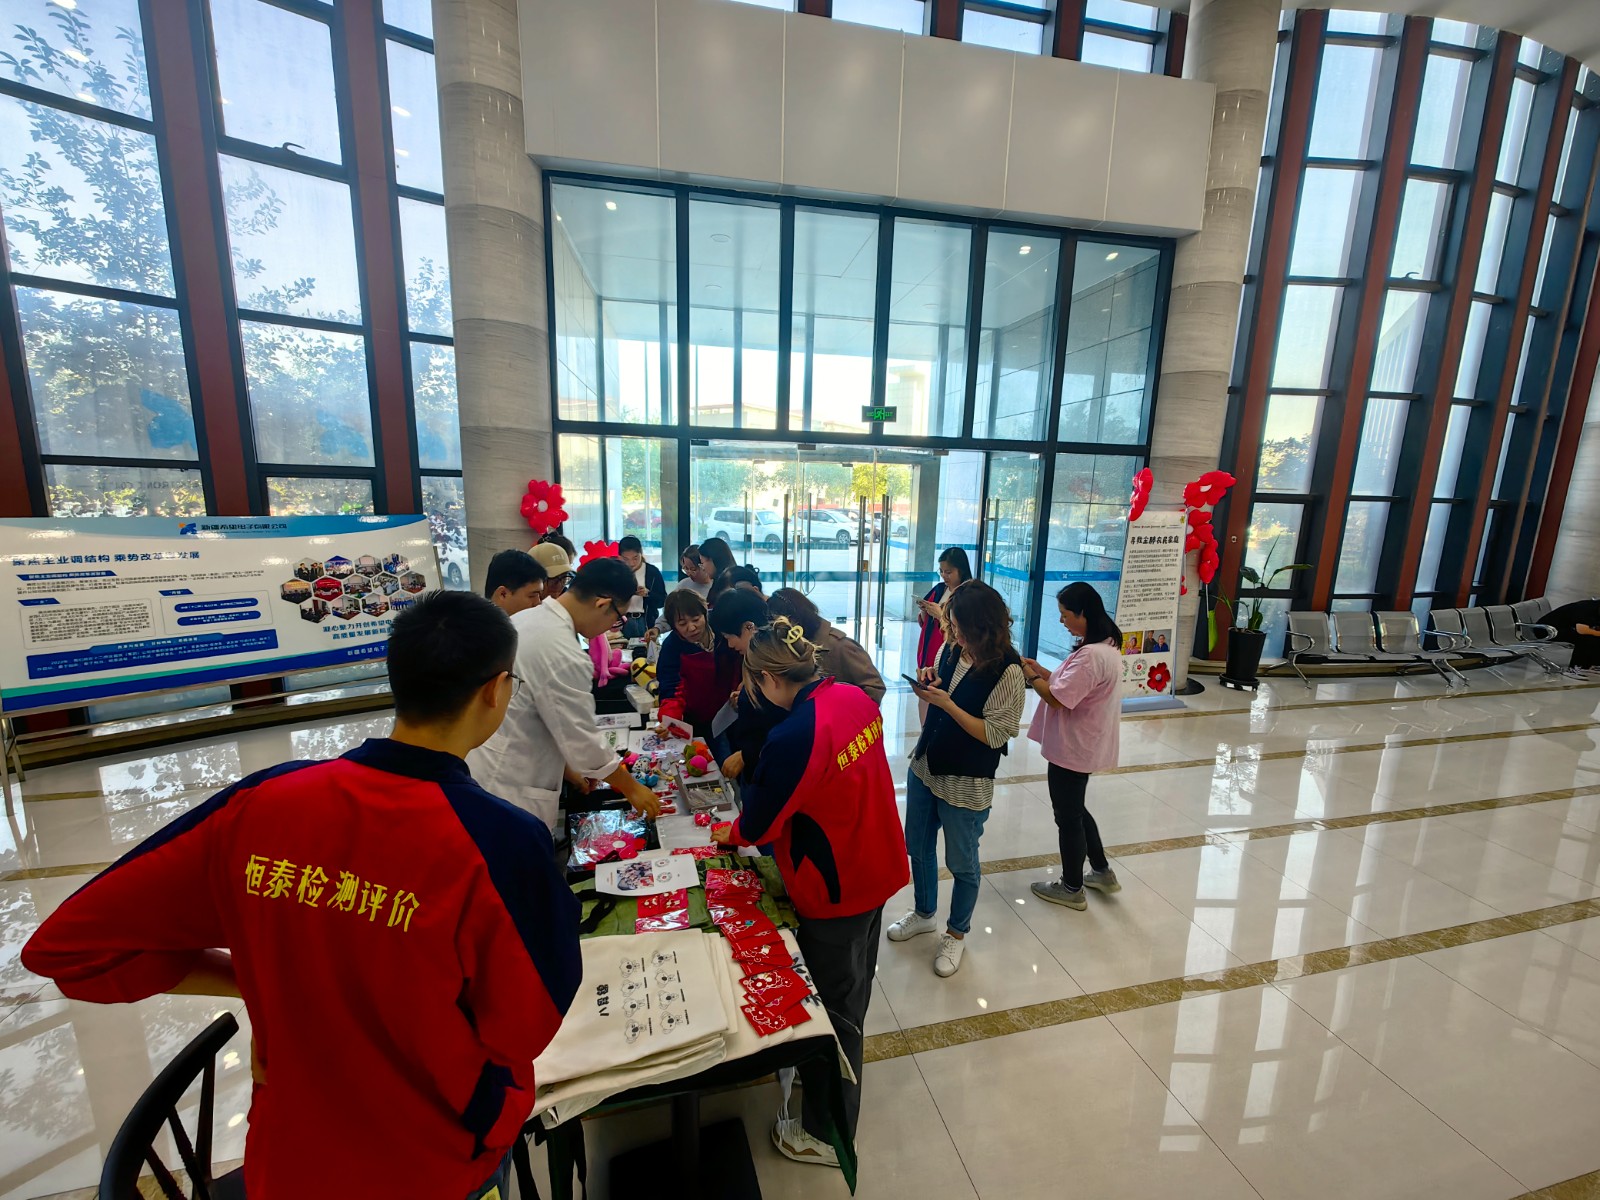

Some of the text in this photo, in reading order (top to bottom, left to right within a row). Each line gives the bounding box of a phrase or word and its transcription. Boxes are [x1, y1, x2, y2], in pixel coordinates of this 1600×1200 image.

[245, 854, 420, 933] 恒泰检测评价
